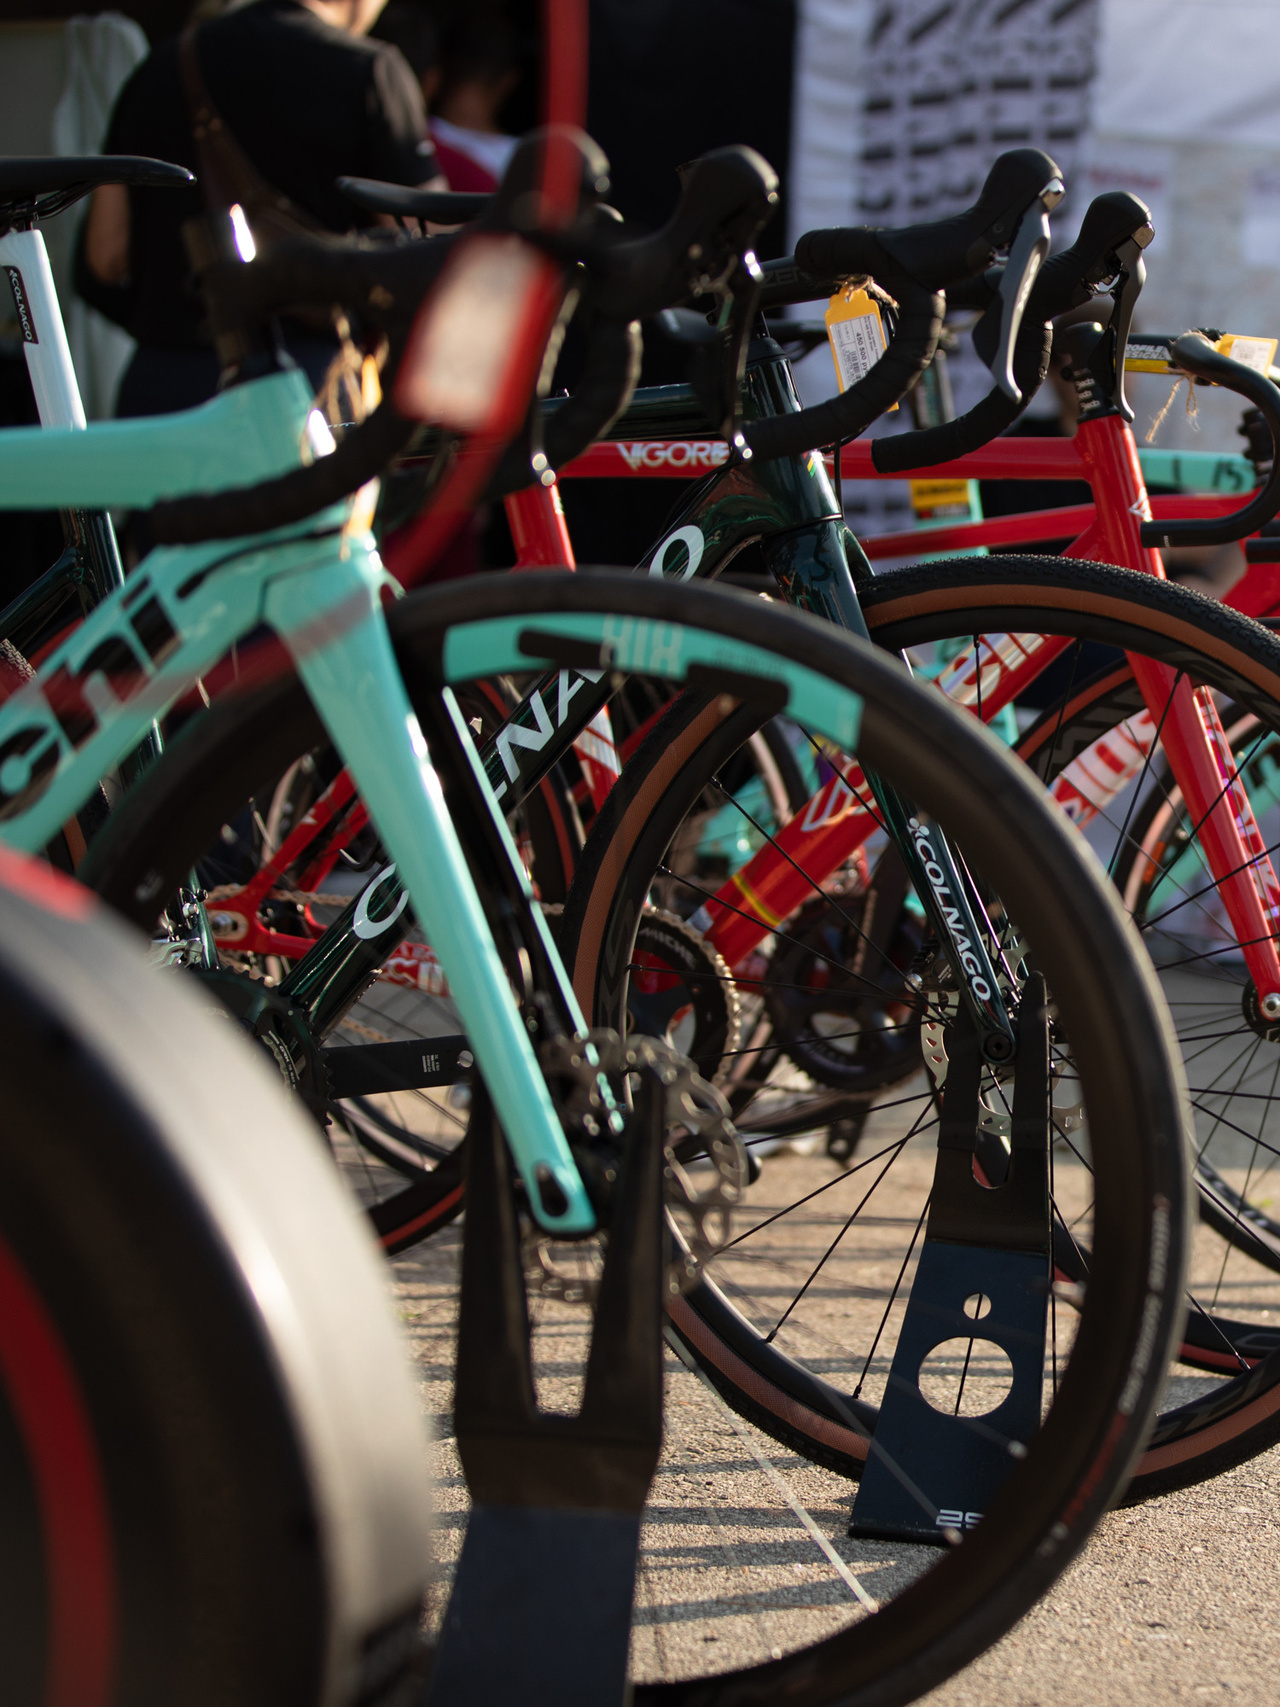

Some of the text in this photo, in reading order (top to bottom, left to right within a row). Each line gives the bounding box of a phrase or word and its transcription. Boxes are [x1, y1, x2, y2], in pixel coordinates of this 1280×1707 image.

[12, 277, 33, 341] COLNAGO
[856, 332, 864, 346] 450
[859, 347, 867, 361] 500
[916, 838, 991, 1001] COLNAGO
